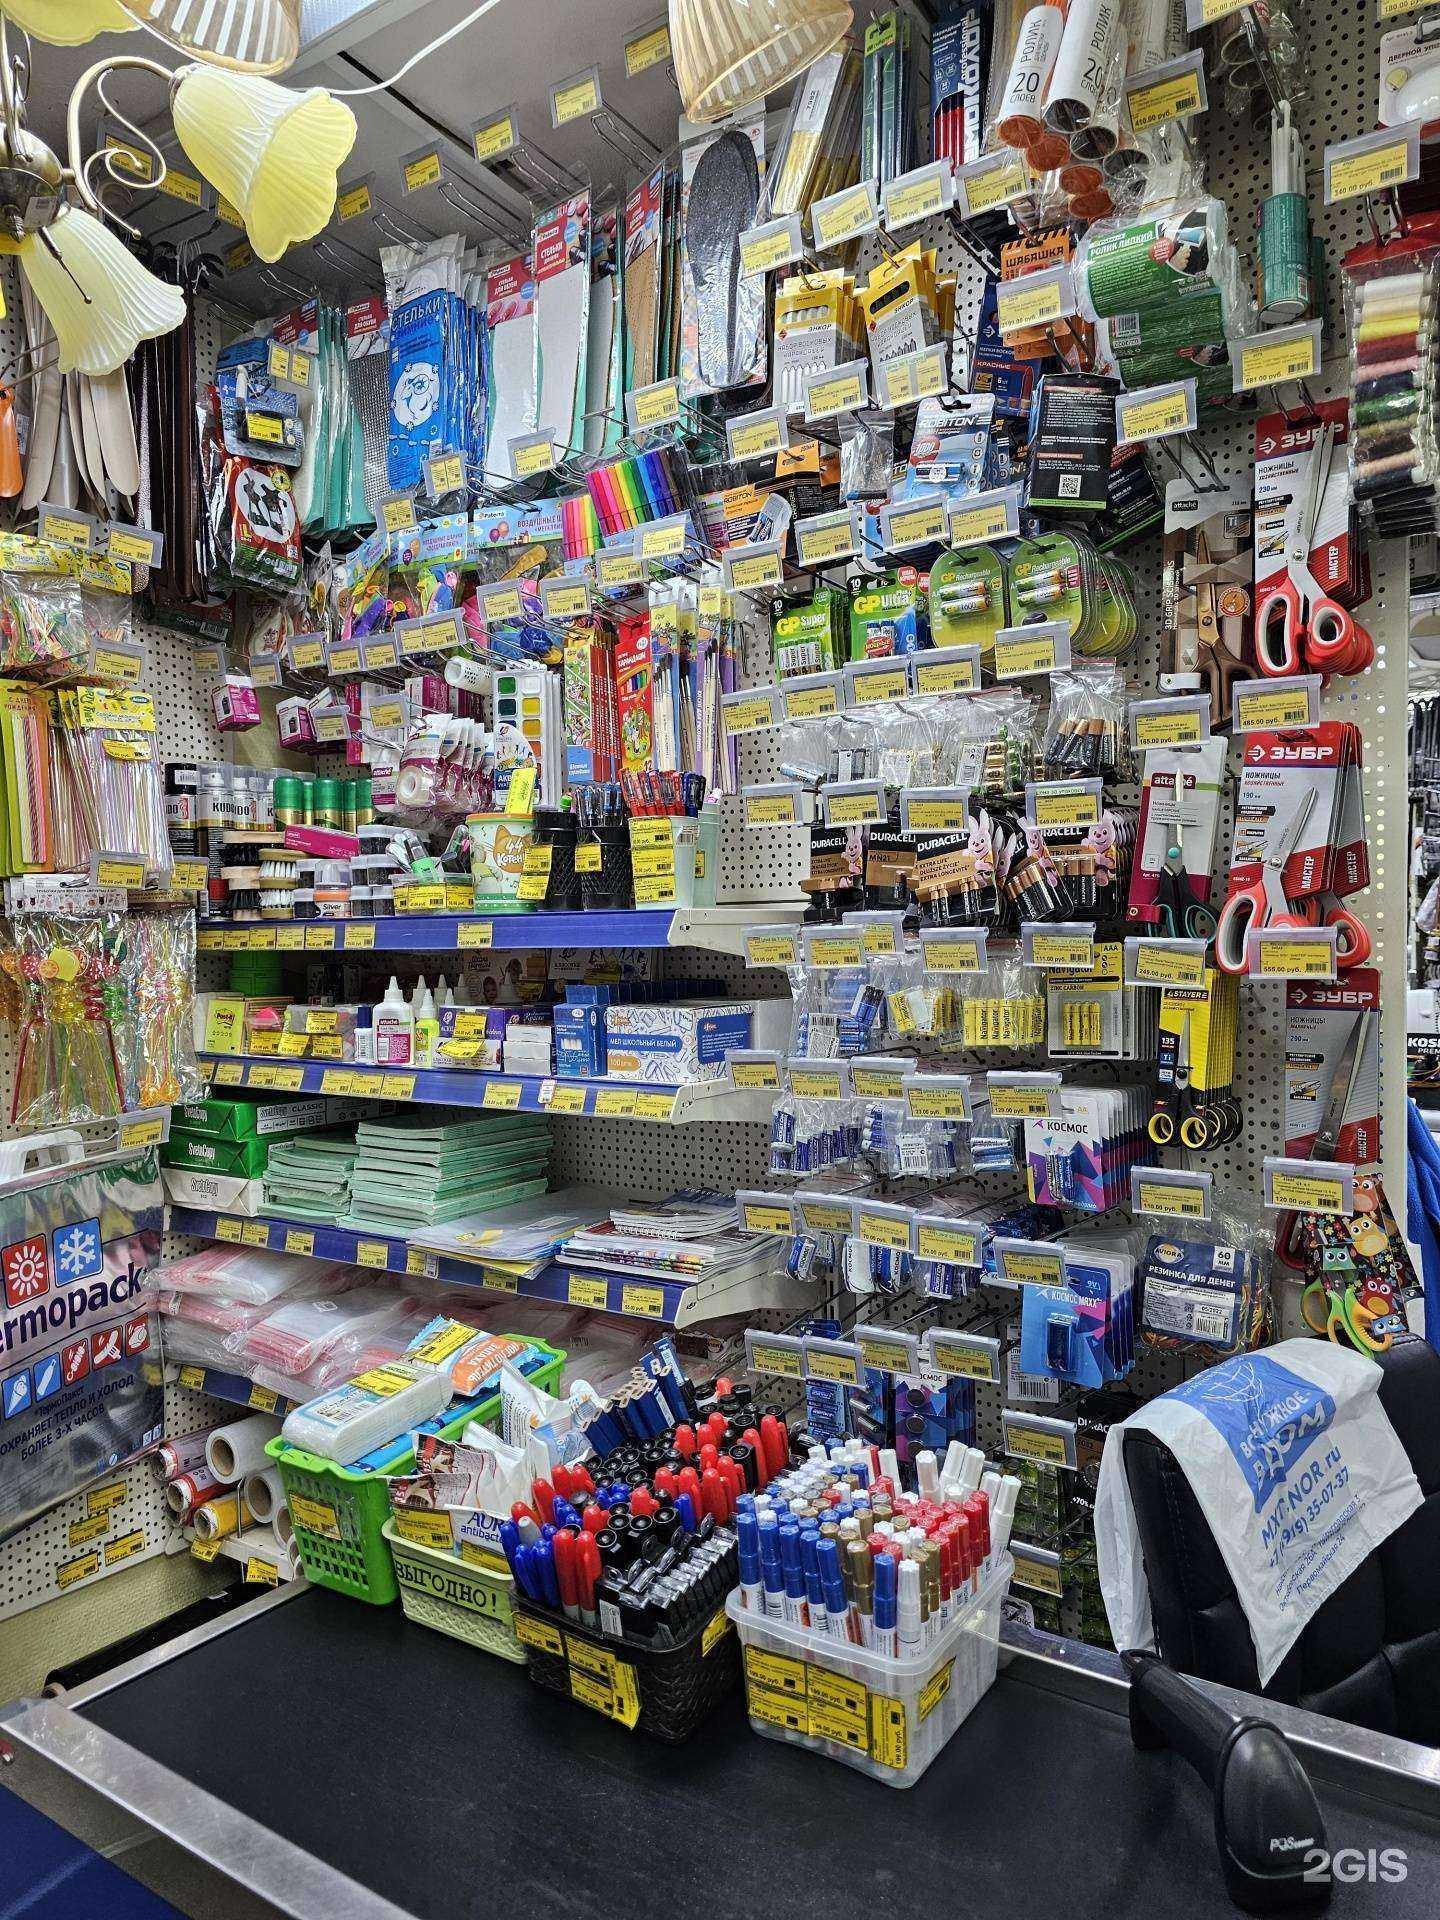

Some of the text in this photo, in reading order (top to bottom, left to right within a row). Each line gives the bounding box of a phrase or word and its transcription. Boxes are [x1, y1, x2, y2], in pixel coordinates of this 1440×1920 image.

[1090, 4, 1112, 52] РОЛИК
[1020, 18, 1042, 62] РОЛИК
[1388, 48, 1422, 64] ДВЕРНОЙ
[1013, 72, 1040, 94] 20
[1090, 243, 1117, 256] РОЛИК
[1006, 246, 1064, 267] ШАБАШКА
[392, 297, 441, 332] СТЕЛЬКИ
[977, 361, 1011, 370] КРАСНЫЕ
[1258, 462, 1295, 474] НОЖНИЦЫ
[1259, 486, 1270, 494] 230
[518, 516, 556, 528] ВОЗДУШНЫЕ
[1328, 546, 1340, 580] МАСТЕР
[850, 578, 861, 589] 10
[772, 600, 783, 608] 10
[854, 594, 910, 615] GP Ultra
[1164, 600, 1174, 617] GRIP
[776, 614, 827, 636] GP Super
[1164, 619, 1173, 630] 3D
[1265, 718, 1279, 726] руб.
[1160, 736, 1174, 744] руб.
[1270, 746, 1334, 760] ЗУБР
[1245, 772, 1281, 780] НОЖНИЦЫ
[505, 840, 524, 852] 44
[812, 837, 847, 850] DURACELL
[918, 834, 968, 852] DURACELL
[1301, 856, 1315, 889] МАСТЕР
[1348, 851, 1358, 884] МАСТЕР
[322, 902, 342, 912] Silver
[1312, 992, 1373, 1004] ЗУБР
[216, 1012, 234, 1022] Post-it
[1290, 1016, 1326, 1025] НОЖНИЦЫ
[610, 1038, 676, 1048] МЕЛ ШКОЛЬНЫЙ БЕЛЫЙ
[1162, 1037, 1174, 1046] 135
[291, 1102, 325, 1112] CLASSIC
[1047, 1122, 1088, 1134] КОСМОС
[1357, 1127, 1368, 1159] МАСТЕР
[1155, 1248, 1182, 1258] AVIORA
[1218, 1250, 1231, 1260] 60
[1148, 1265, 1236, 1288] РЕЗИНКА ДЛЯ ДЕНЕГ
[54, 1398, 88, 1424] ТЕПЛО
[88, 1392, 96, 1406] И
[97, 1374, 135, 1398] ХОЛОД
[20, 1403, 106, 1462] БОЛЕЕ 3-Х ЧАСОВ
[1306, 1465, 1351, 1522] 35-07-37
[394, 1560, 487, 1608] ВЫГОДНО
